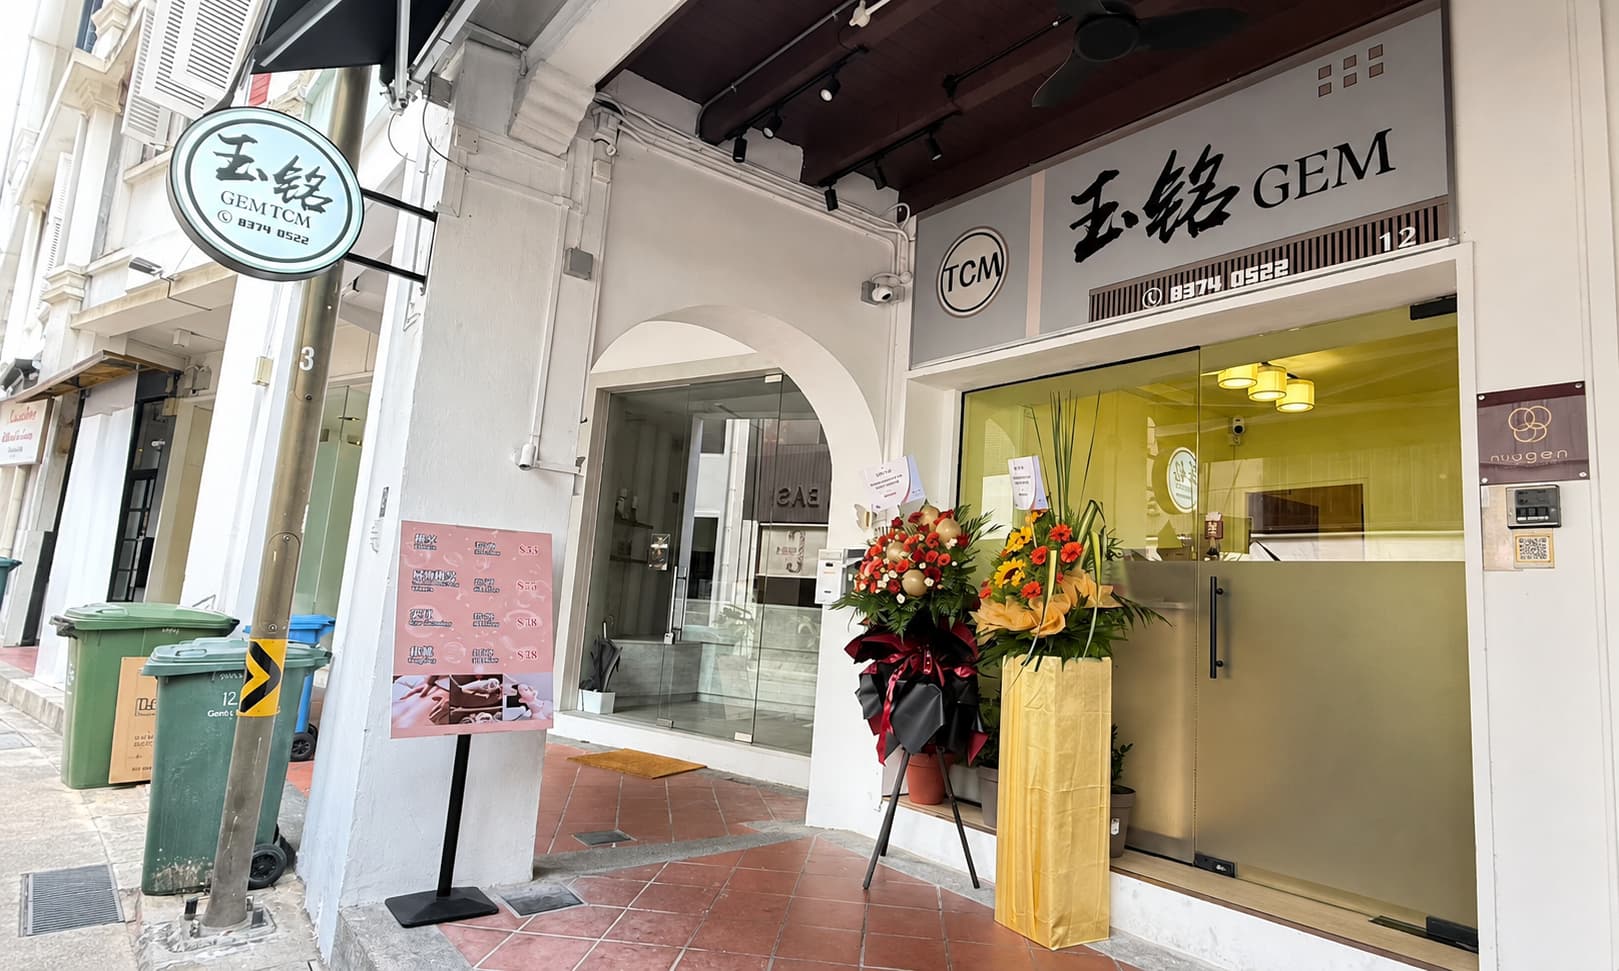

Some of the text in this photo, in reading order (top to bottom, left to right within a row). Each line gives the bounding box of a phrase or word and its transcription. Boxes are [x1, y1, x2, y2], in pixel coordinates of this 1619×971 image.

[1252, 127, 1397, 210] GEM
[220, 190, 312, 229] GEM TCM
[237, 217, 310, 246] 8374 0522
[1378, 226, 1418, 252] 12
[943, 251, 1001, 293] TCM
[1169, 257, 1290, 303] 8374 0522
[299, 346, 315, 371] 3
[223, 691, 238, 706] 12
